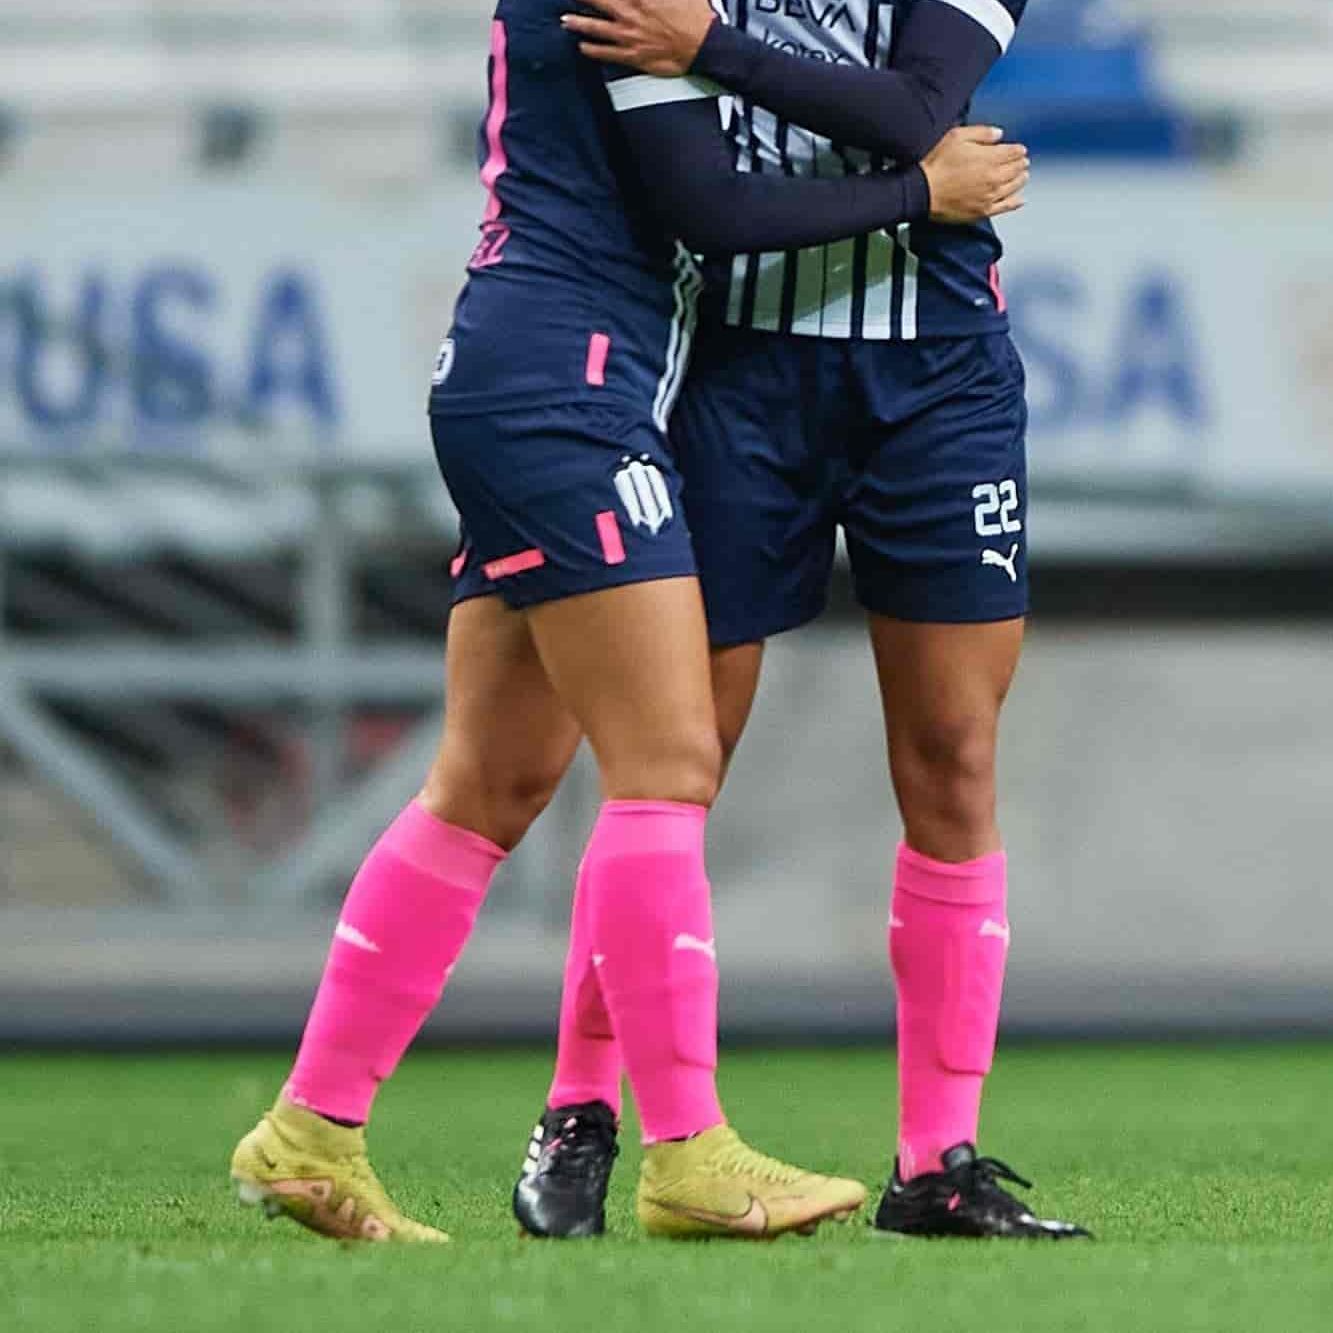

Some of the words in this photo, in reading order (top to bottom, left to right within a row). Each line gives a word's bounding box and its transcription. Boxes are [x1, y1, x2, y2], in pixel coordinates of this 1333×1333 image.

[0, 264, 338, 434] USA
[1008, 266, 1206, 434] SA
[972, 479, 1021, 536] 22
